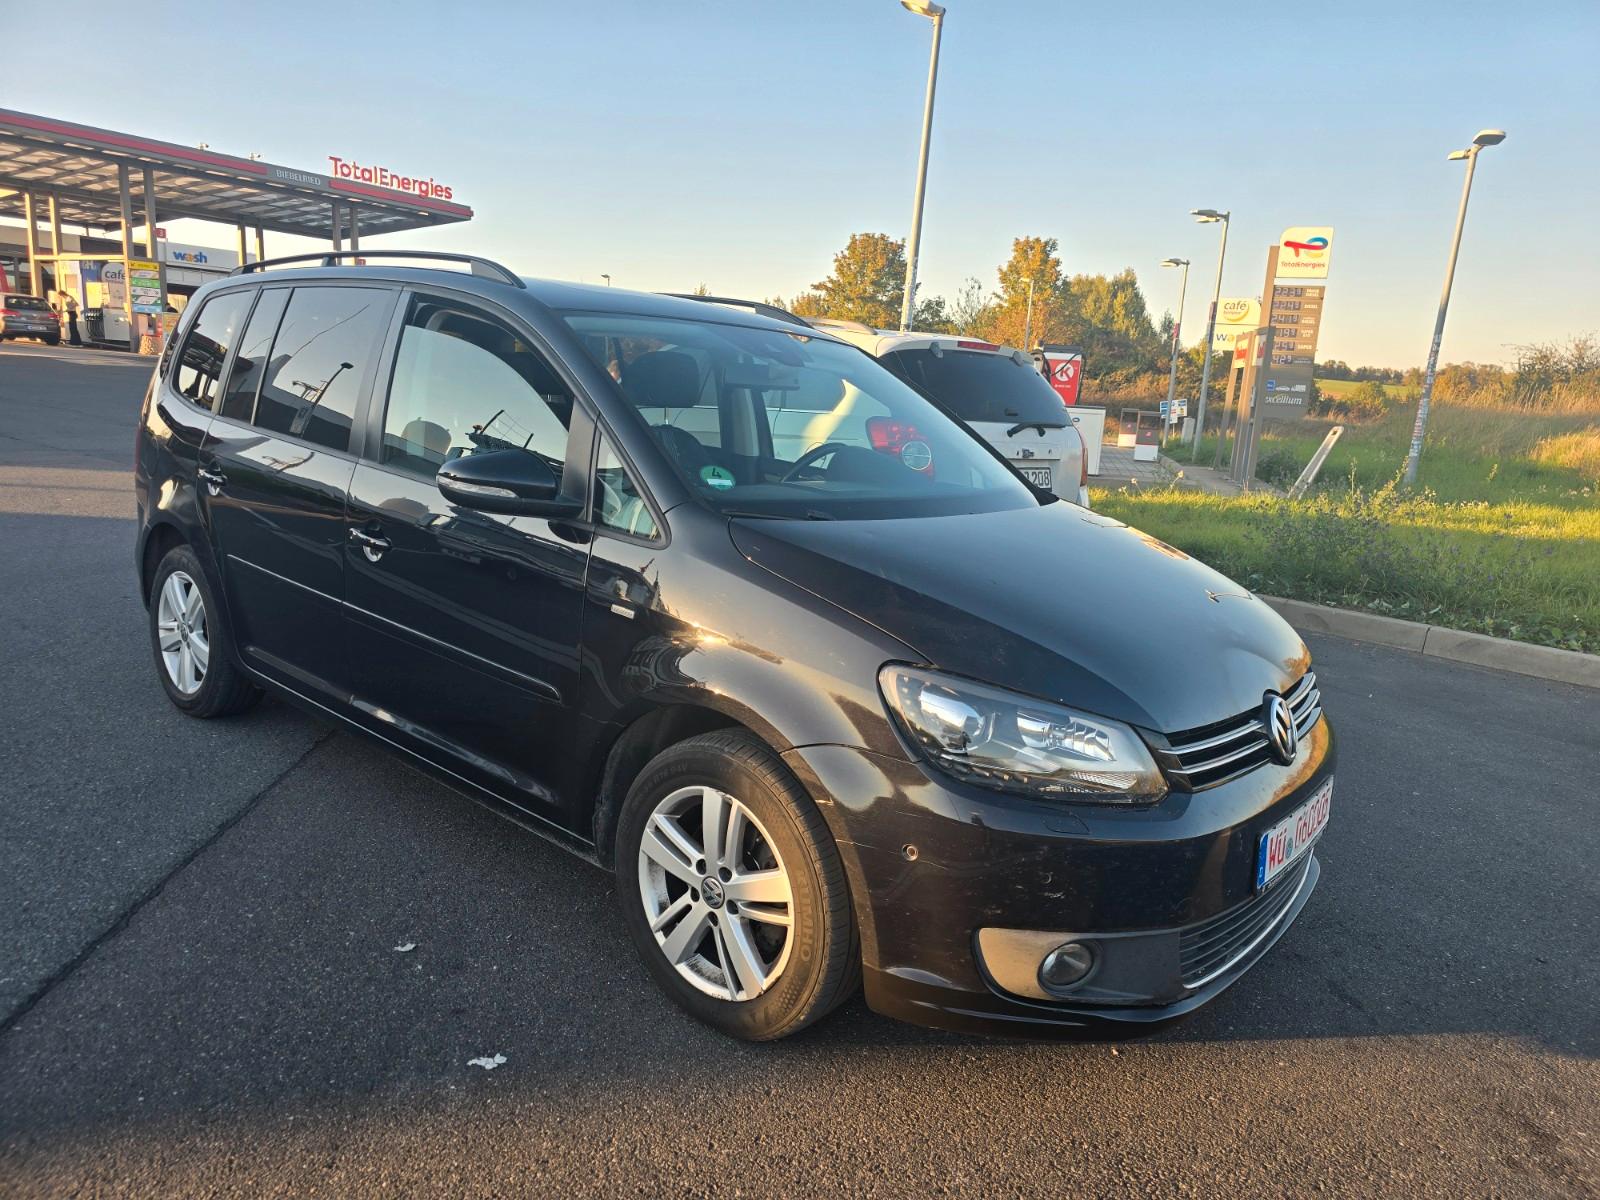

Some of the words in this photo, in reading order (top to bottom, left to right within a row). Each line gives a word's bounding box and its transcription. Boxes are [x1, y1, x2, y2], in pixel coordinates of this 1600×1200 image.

[276, 169, 321, 186] BIEBELRIED
[329, 155, 453, 200] TotalEnergies
[173, 251, 208, 264] wash
[1281, 261, 1326, 269] TotalEnergies
[1224, 300, 1247, 311] café
